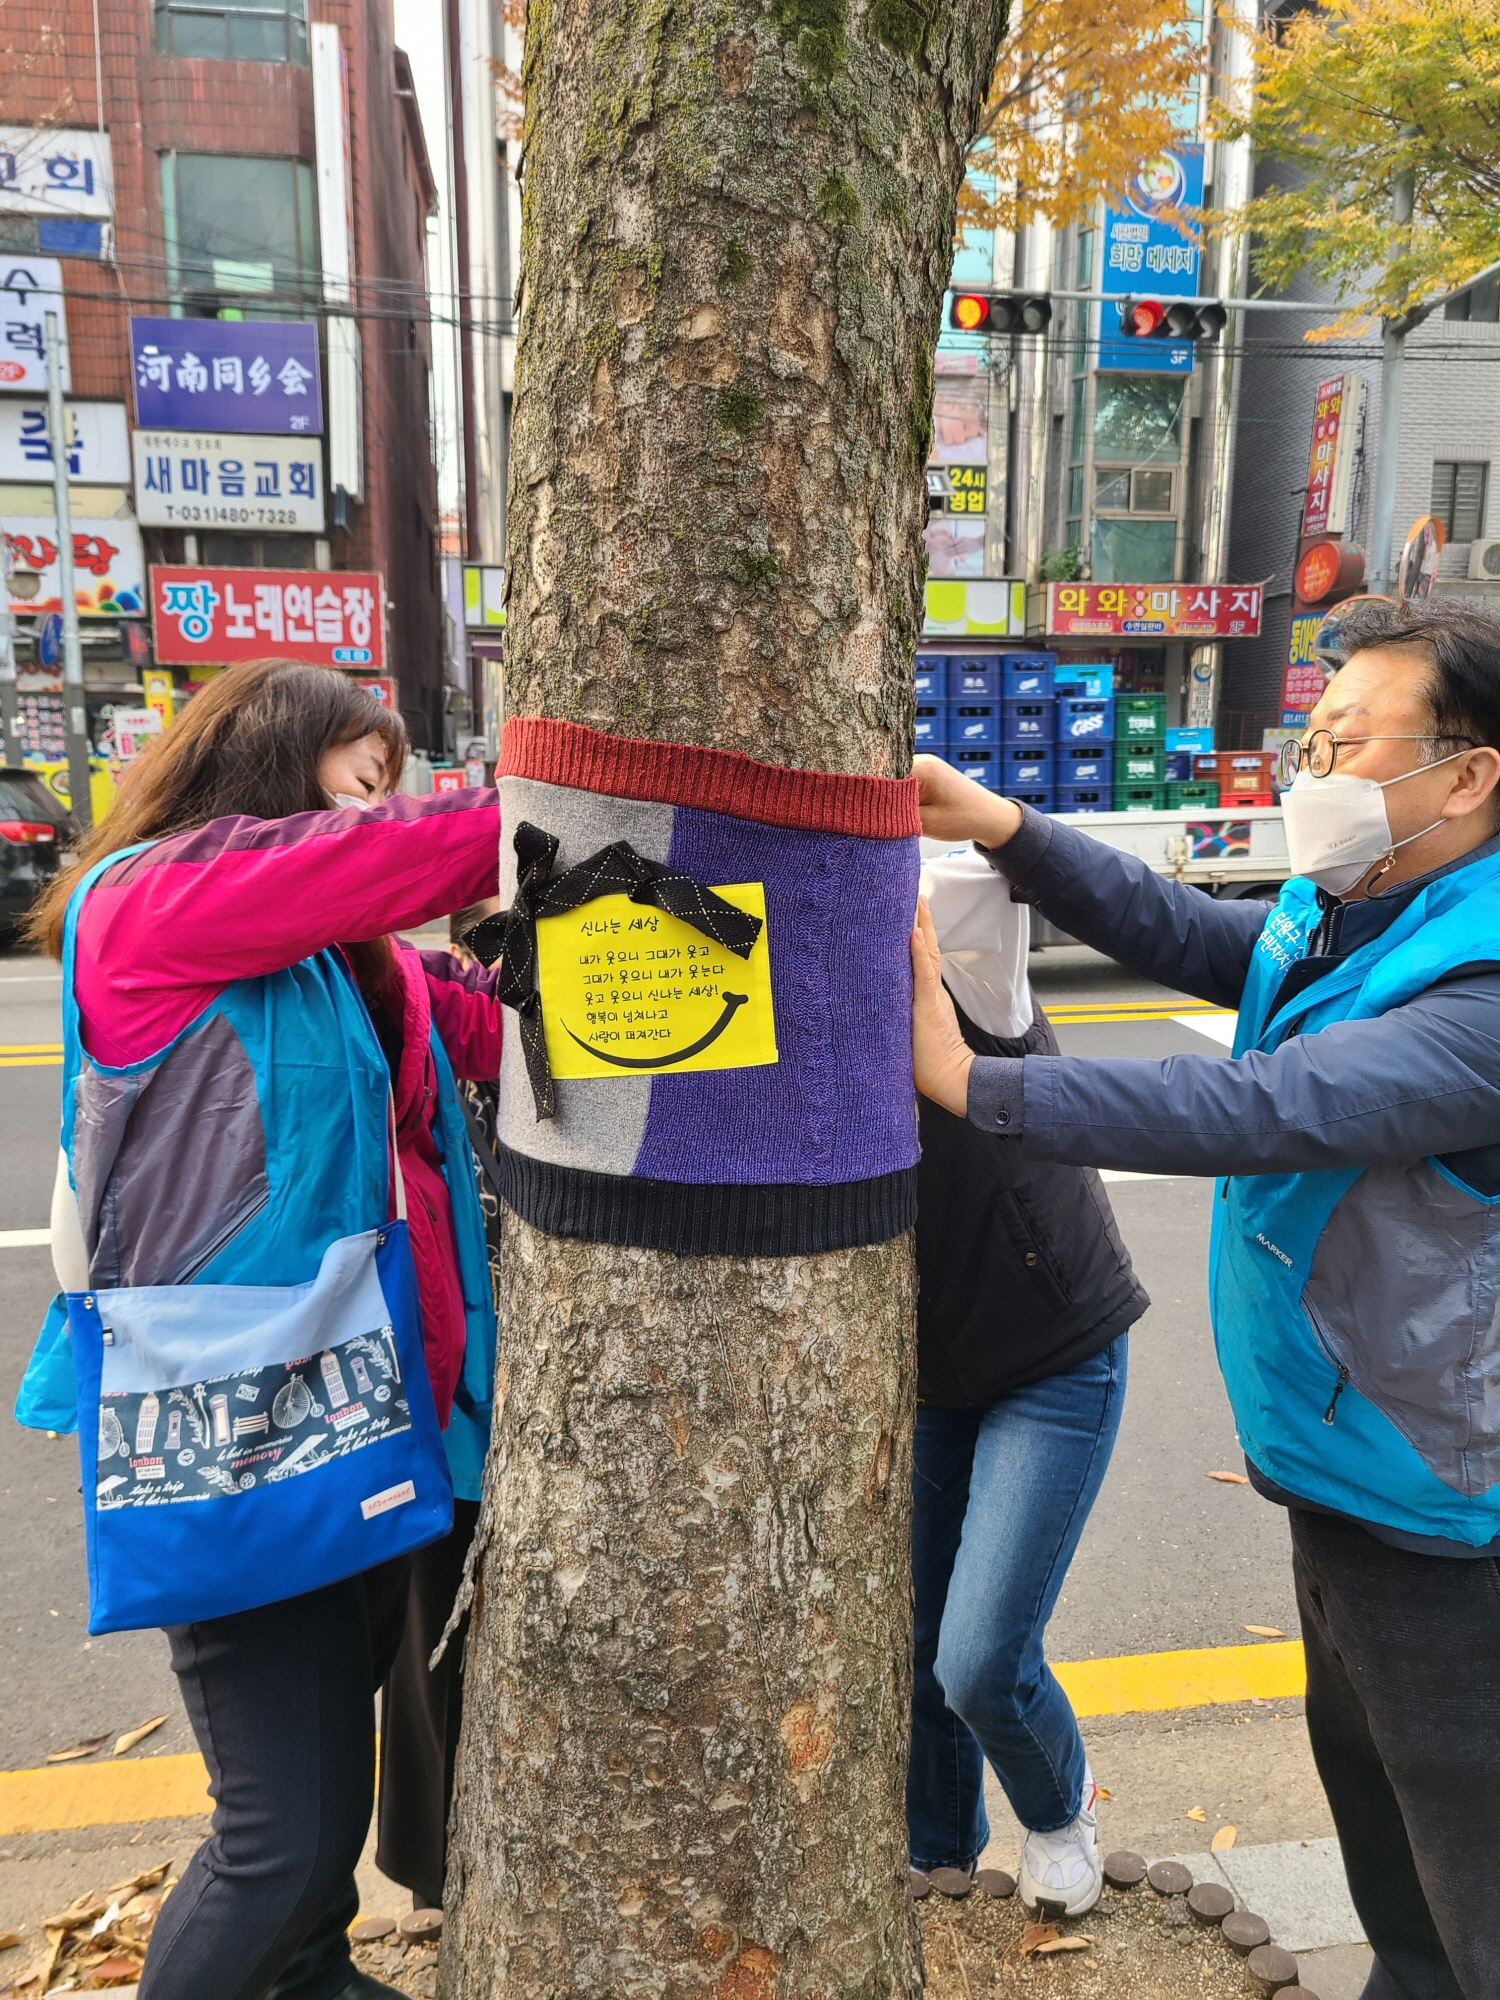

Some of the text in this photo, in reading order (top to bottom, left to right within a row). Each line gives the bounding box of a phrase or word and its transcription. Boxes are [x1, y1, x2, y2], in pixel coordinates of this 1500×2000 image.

[1109, 243, 1194, 275] 희망 메세지
[1170, 350, 1188, 365] 3F
[137, 352, 314, 396] 河南同乡会
[144, 456, 316, 500] 새마음교회
[950, 467, 985, 488] 24시
[161, 579, 374, 646] 짱 노래연습장
[1151, 588, 1258, 619] 마사지
[1229, 620, 1246, 633] 2F
[581, 916, 659, 936] 신나는 세상
[1270, 911, 1301, 944] 단원구
[579, 944, 710, 965] 내가 웃으니 그대가 웃고
[1257, 928, 1293, 977] 주민자치
[583, 964, 725, 985] 그대가 웃으니 내가 웃는다
[585, 984, 719, 1006] 웃고 웃으니 신나는 세상!
[586, 1009, 669, 1025] 행복이 넘쳐나고
[588, 1028, 671, 1043] 사랑이 퍼져간다
[1256, 1233, 1293, 1268] MARKER
[368, 1416, 391, 1431] trip
[230, 1446, 285, 1469] memory
[243, 1447, 253, 1456] in
[163, 1481, 184, 1495] trip
